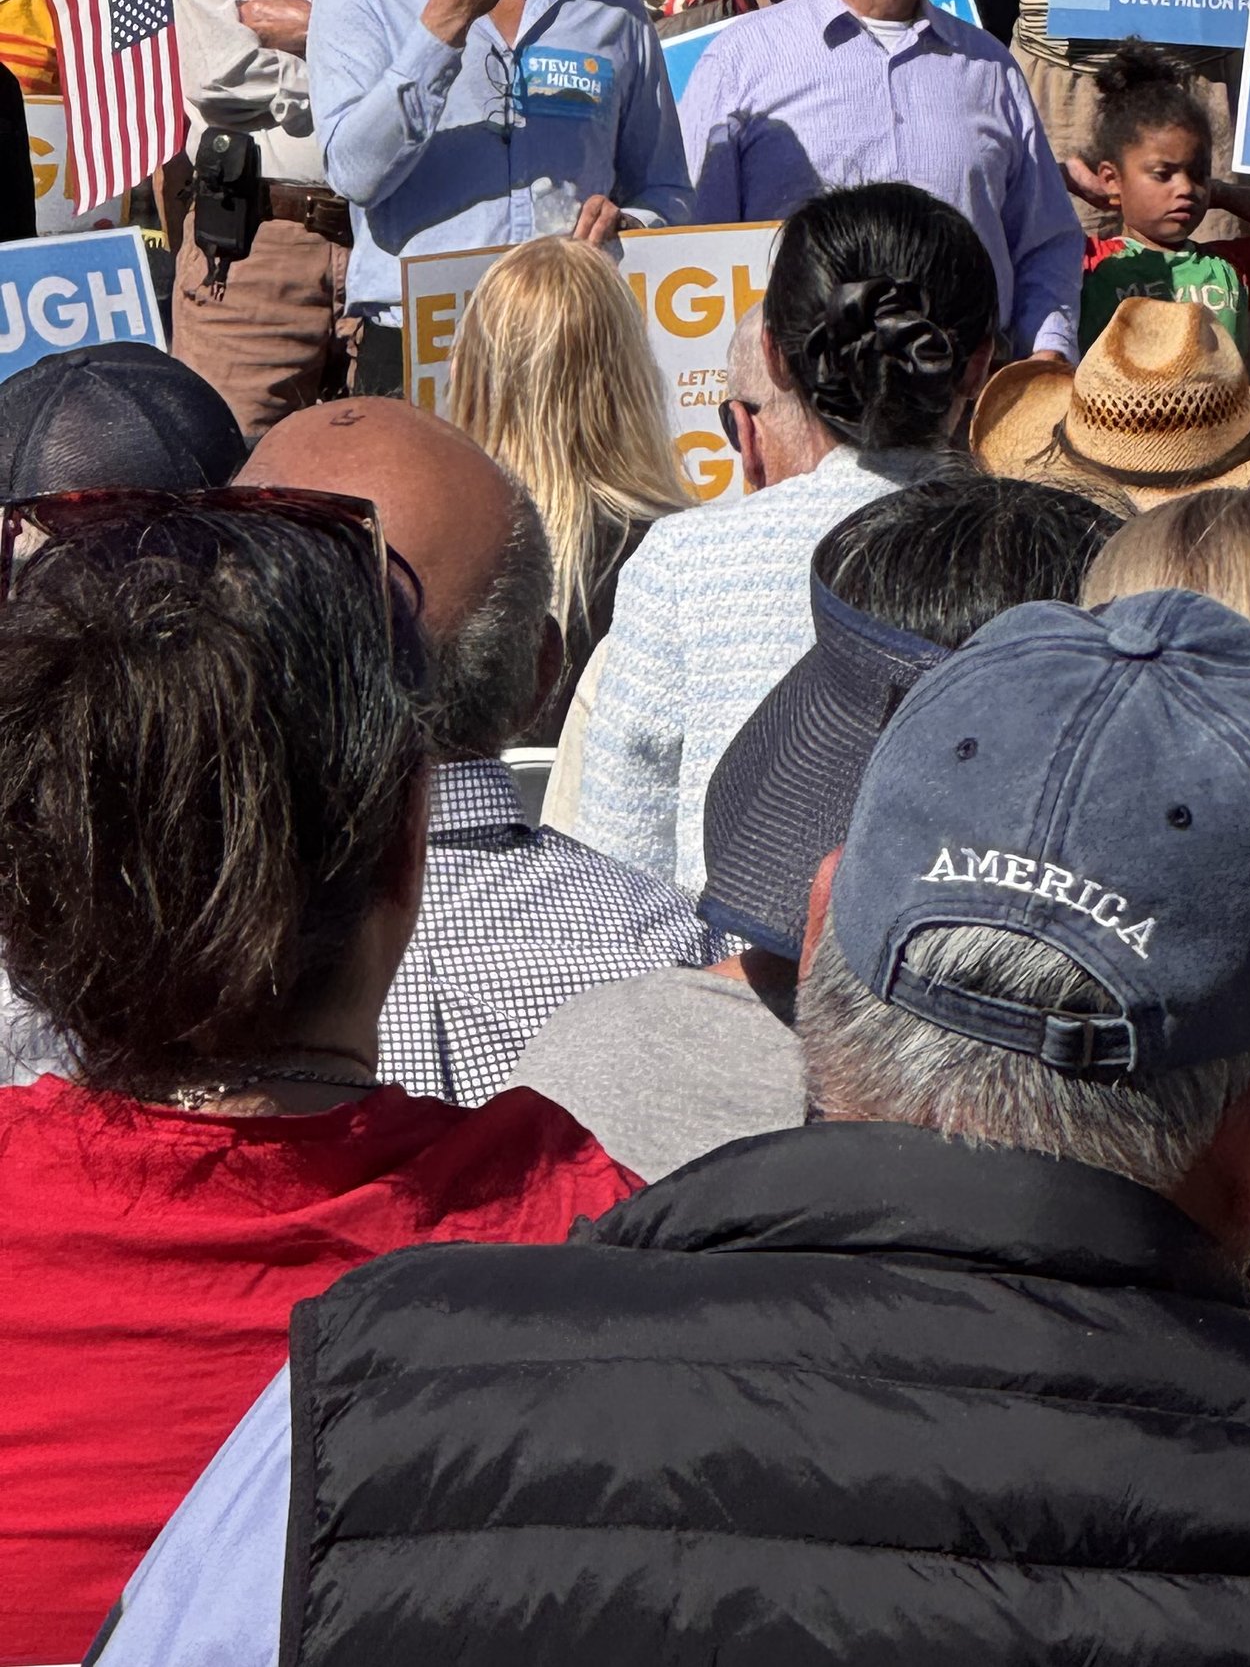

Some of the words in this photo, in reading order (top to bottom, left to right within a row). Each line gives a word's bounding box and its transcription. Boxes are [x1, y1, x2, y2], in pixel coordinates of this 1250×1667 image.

[528, 57, 578, 75] STEVE
[546, 72, 602, 94] HILTON
[919, 847, 1160, 960] AMERICA
